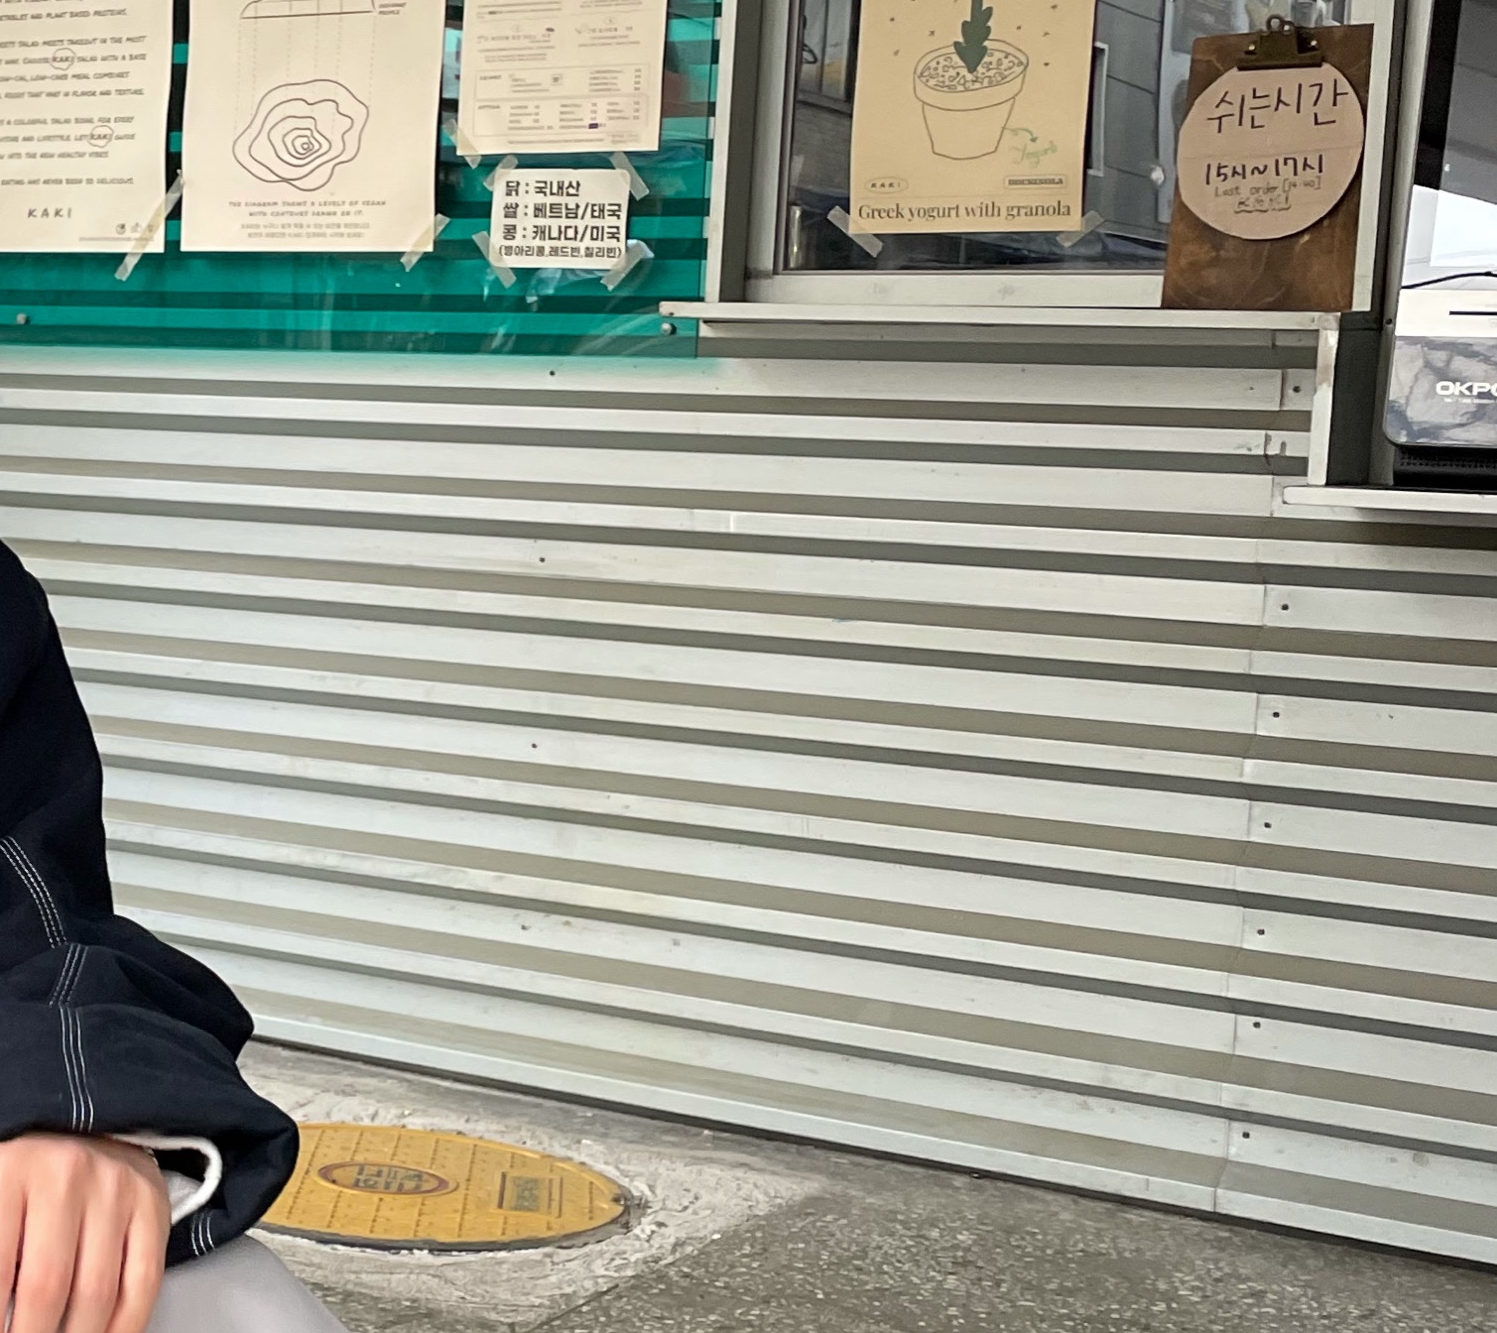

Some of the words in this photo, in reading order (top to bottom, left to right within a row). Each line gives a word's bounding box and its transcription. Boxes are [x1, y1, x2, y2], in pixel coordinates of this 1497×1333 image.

[504, 180, 521, 197] 닭
[534, 180, 581, 197] 국내산
[1215, 186, 1240, 197] Last
[1249, 181, 1279, 196] order
[28, 208, 73, 218] KAKI
[503, 202, 519, 220] 쌀
[533, 202, 623, 221] 베트남/태국
[858, 202, 905, 220] Greek
[907, 203, 961, 223] yogurt
[963, 200, 1001, 219] with
[1005, 199, 1071, 220] granola
[501, 223, 518, 242] 콩
[531, 224, 621, 243] 캐나다/미국
